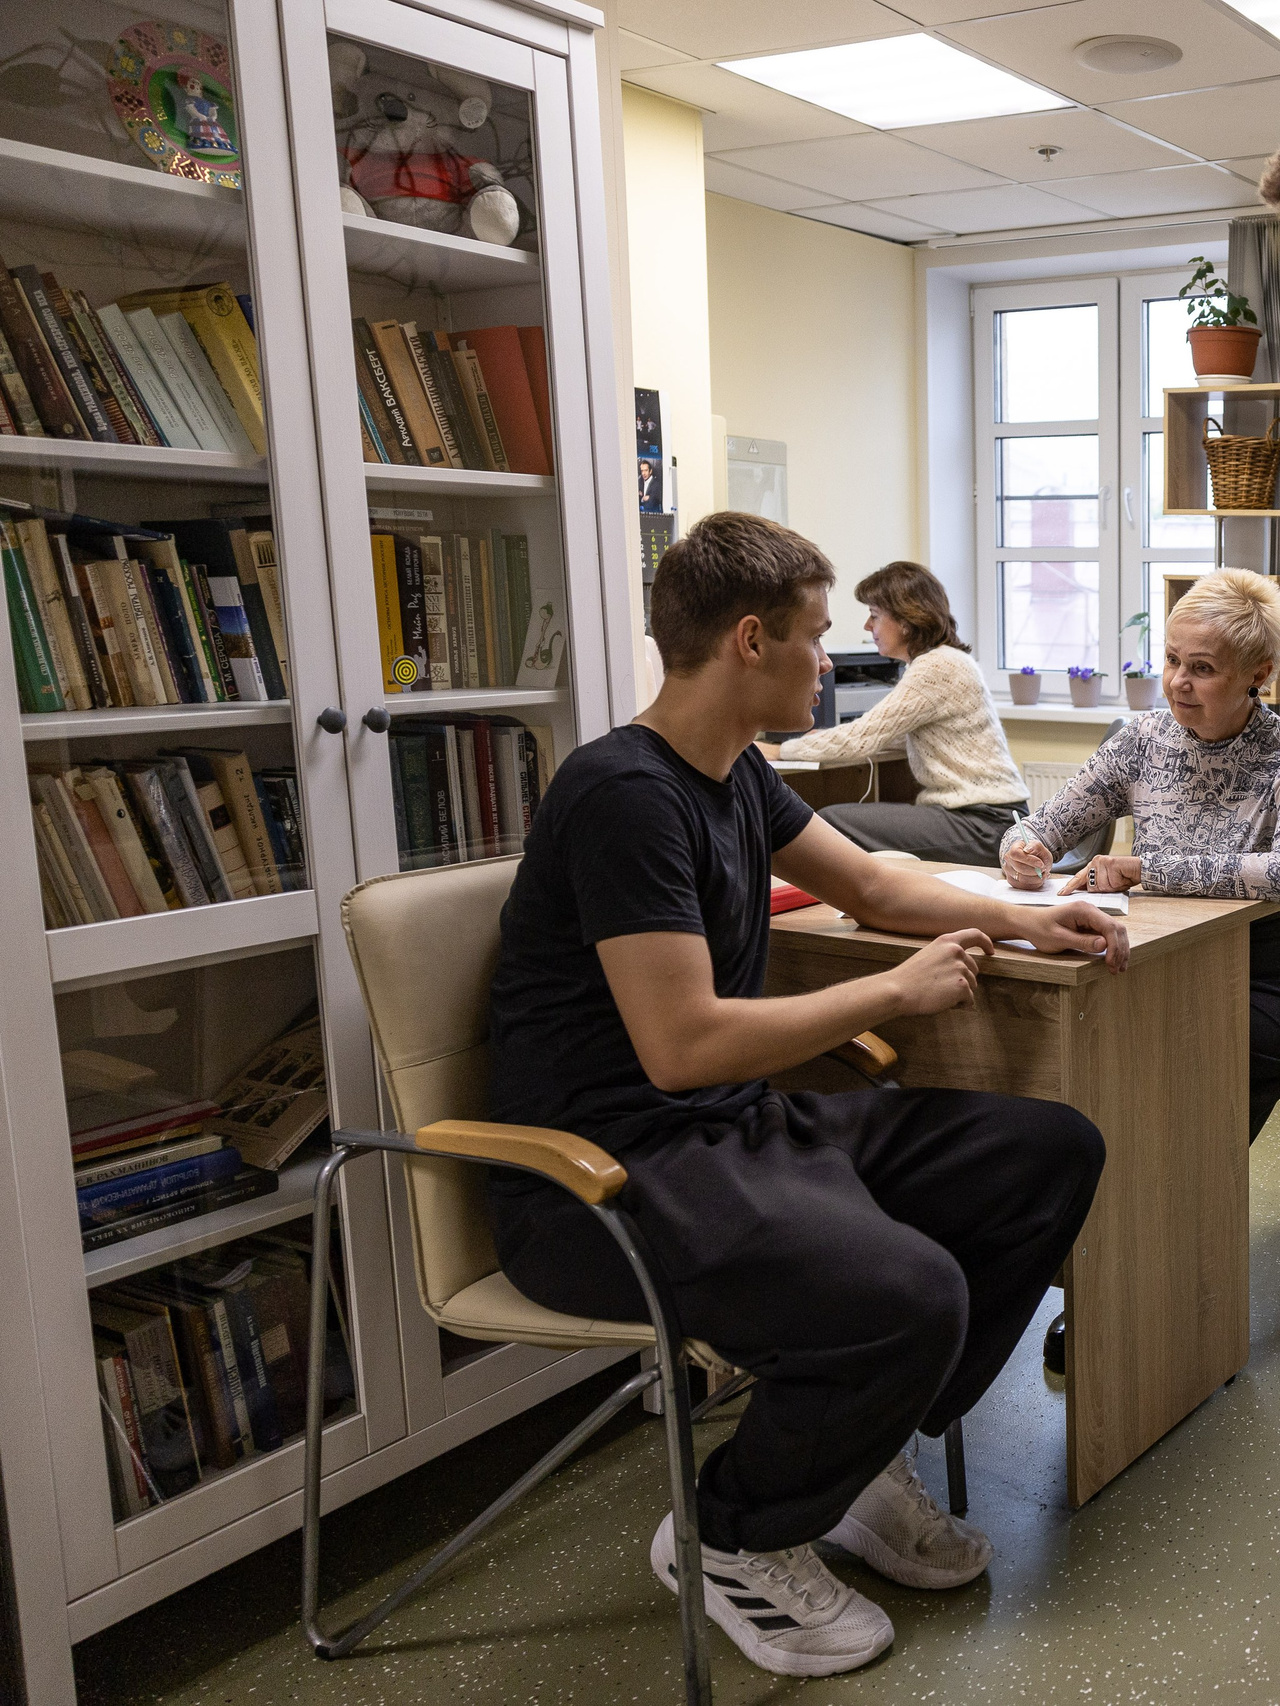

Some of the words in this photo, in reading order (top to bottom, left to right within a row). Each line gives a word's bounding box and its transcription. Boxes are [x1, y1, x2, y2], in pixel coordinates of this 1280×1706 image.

[33, 288, 48, 308] ВЕКА
[41, 306, 69, 352] СЕРЕБРЯНОГО
[111, 323, 135, 356] СИРОТА
[61, 348, 78, 370] КИНО
[38, 366, 58, 400] ВОСТОКА
[365, 345, 396, 407] ВАКСБЕРГ
[389, 407, 413, 449] Аркадий
[487, 430, 504, 461] ПАВЕЛ
[119, 556, 135, 590] МОСКВЫ
[119, 600, 132, 625] ПОЛО
[130, 592, 143, 620] ТЕАТРЫ
[406, 592, 423, 608] Рид
[410, 613, 422, 639] Майн
[128, 631, 141, 660] МАРКО
[212, 631, 229, 669] СЕРОВА
[39, 664, 48, 676] СТО
[222, 669, 233, 682] М.
[488, 782, 497, 811] ДВАДЦАТИ
[519, 771, 528, 803] СИЛЬНЕЕ
[243, 793, 258, 829] НАСЛЕДИЕ
[436, 789, 448, 822] БЕЛОВ
[96, 1154, 169, 1181] РАХМАНИНОВ
[159, 1167, 200, 1187] БОЛЬШОЙ
[89, 1178, 158, 1208] ДРАМАТИЧЕСКИЙ
[150, 1189, 178, 1202] АРТИСТ
[129, 1204, 195, 1229] КИНОКОМЕДИЯ
[90, 1230, 113, 1242] ВЕКА
[115, 1364, 126, 1397] ИСТОРИЯ
